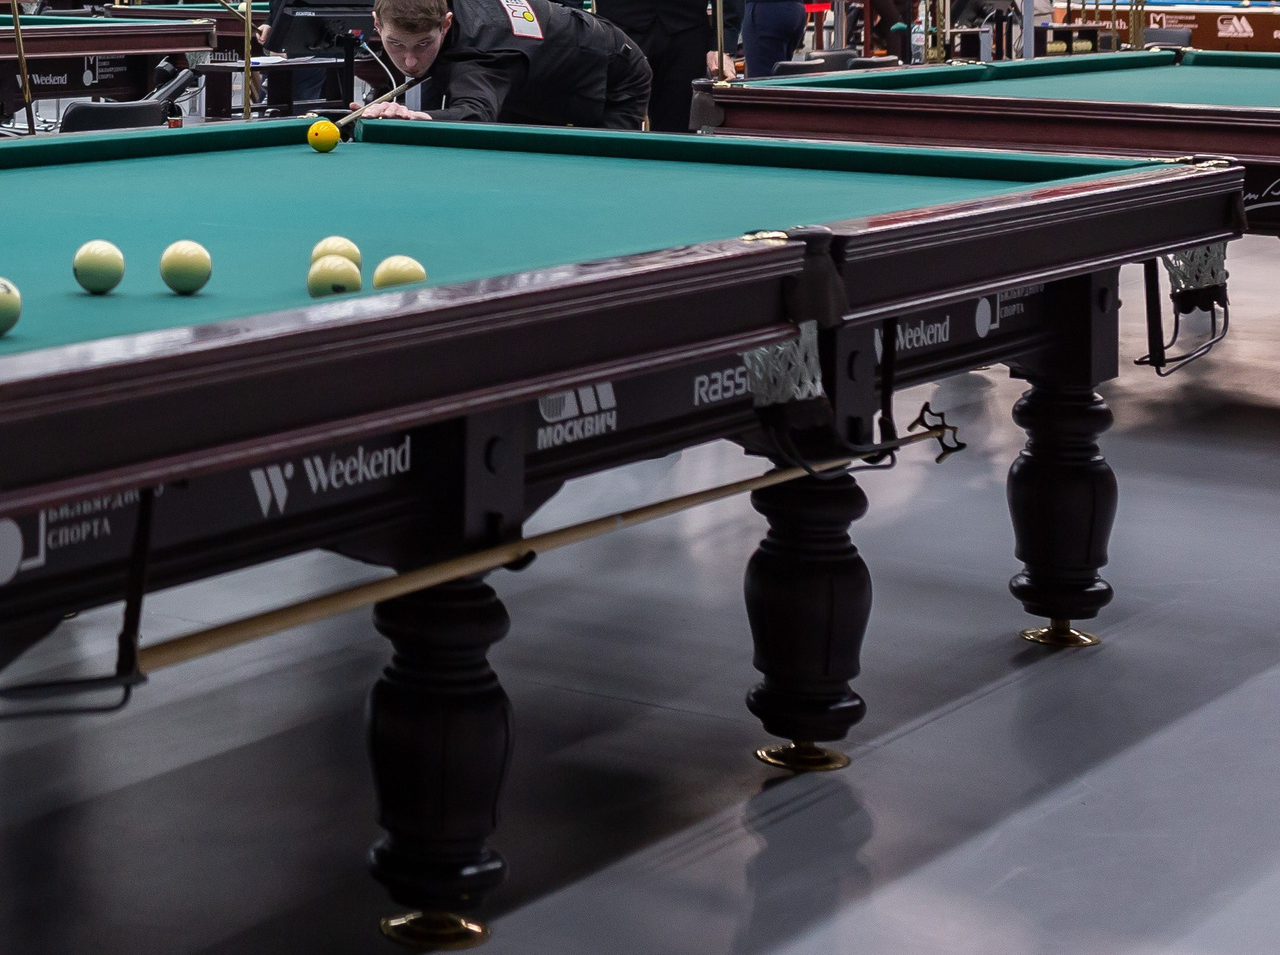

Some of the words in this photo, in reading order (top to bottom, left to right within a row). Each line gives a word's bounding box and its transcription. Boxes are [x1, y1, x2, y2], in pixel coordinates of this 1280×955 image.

[32, 74, 67, 85] Weekend
[694, 366, 751, 406] Rass
[537, 411, 617, 449] МОСКВИЧ
[304, 434, 411, 495] Weekend
[47, 517, 111, 550] СПОРТА
